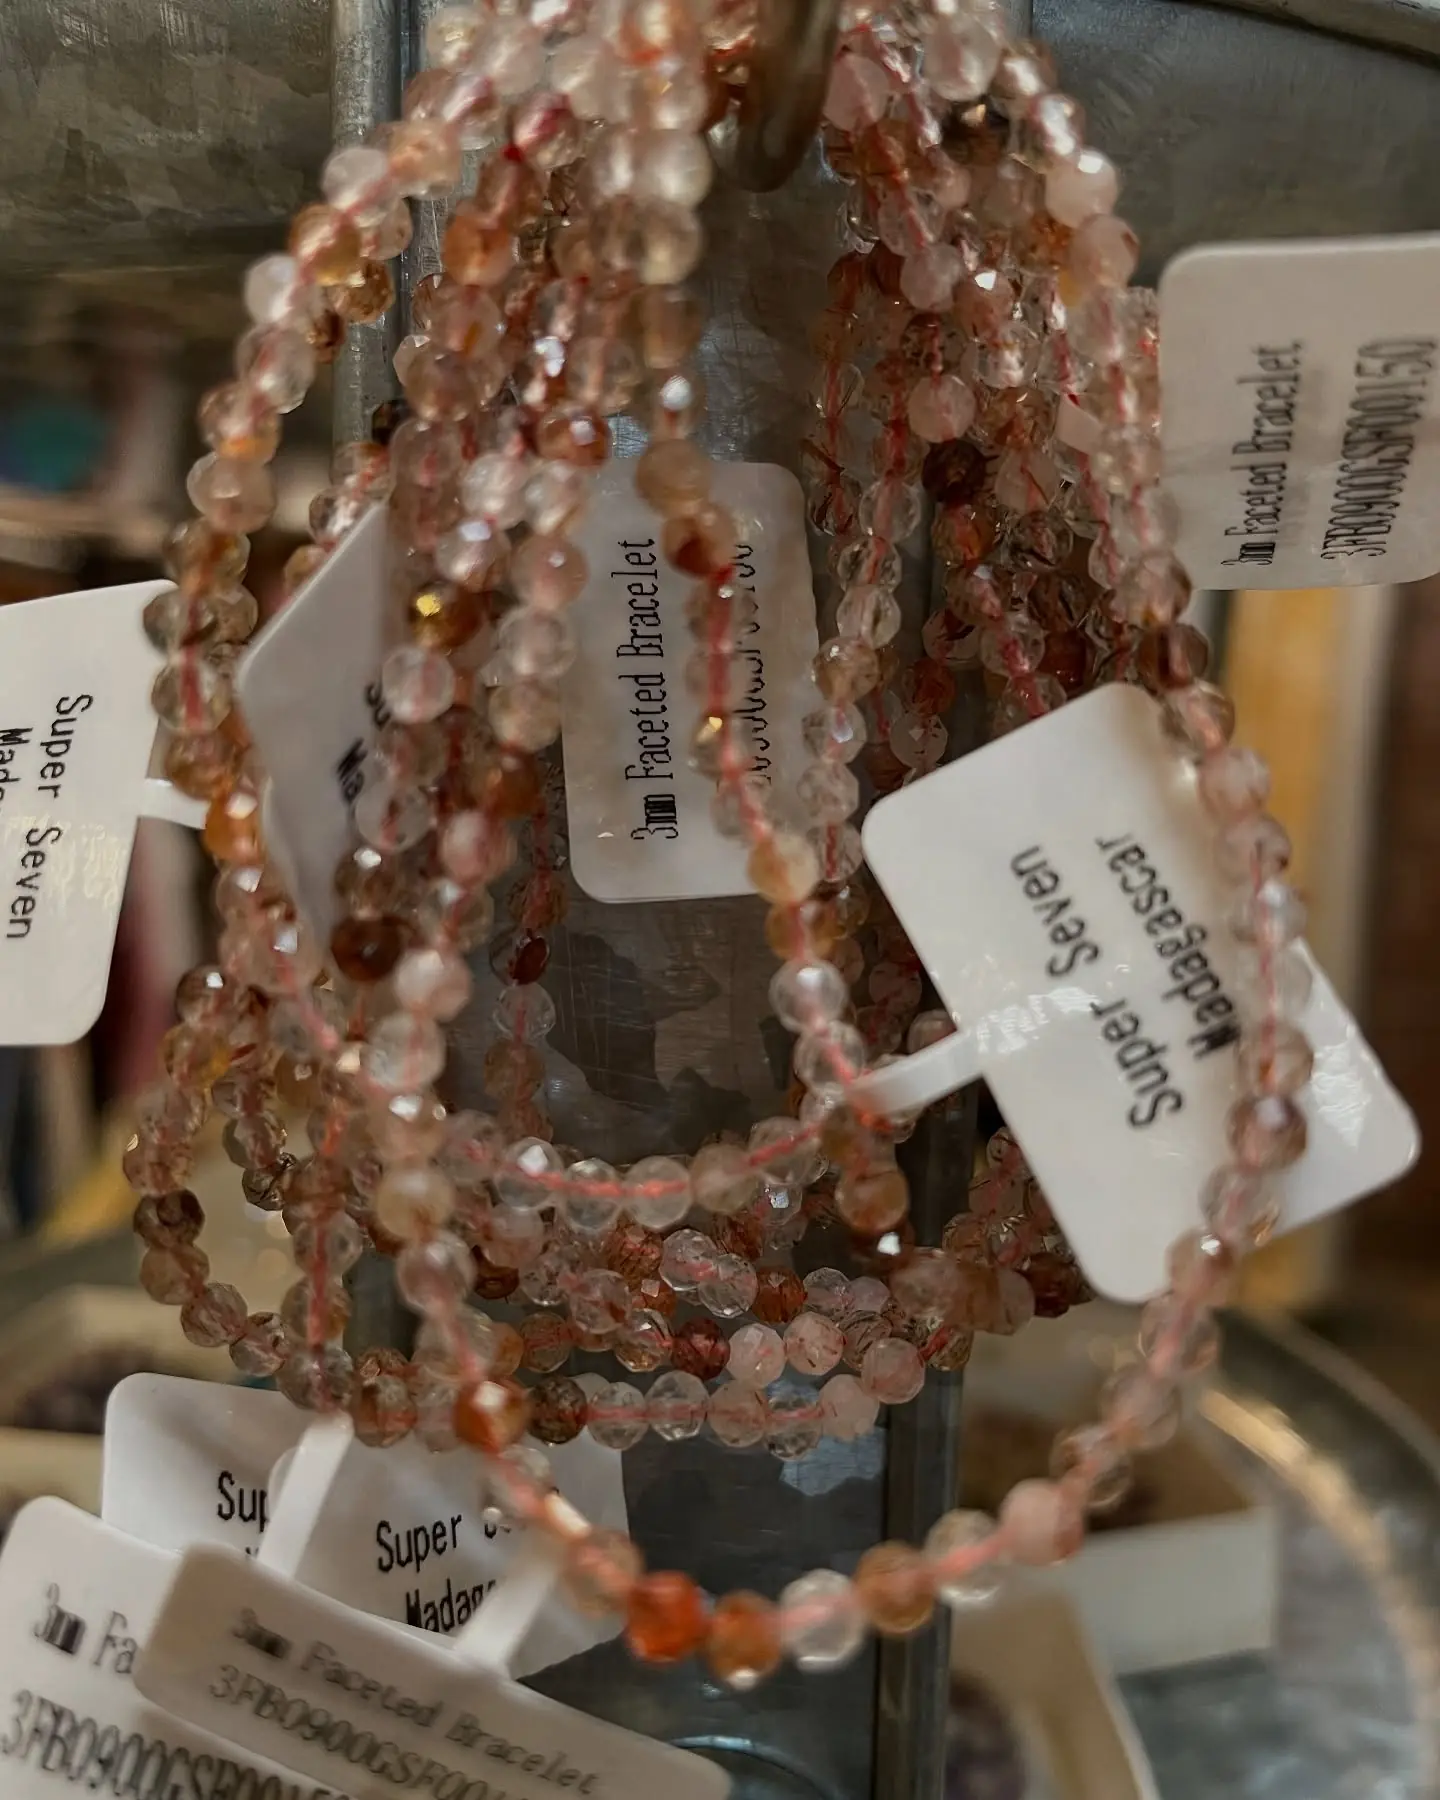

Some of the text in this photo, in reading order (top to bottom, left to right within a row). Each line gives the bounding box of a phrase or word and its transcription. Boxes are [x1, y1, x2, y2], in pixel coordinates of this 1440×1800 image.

[1231, 338, 1303, 455] Bracelet
[1224, 461, 1288, 536] Faceted
[0, 726, 34, 802] Mad
[610, 537, 680, 840] 3mm Faceted Bracelet
[6, 693, 94, 939] Super Seven
[1009, 845, 1184, 1129] Super Seven
[1095, 832, 1242, 1062] Madagascar
[375, 1512, 463, 1574] Super
[300, 1640, 443, 1728] Faceted
[444, 1710, 602, 1796] Bracelet
